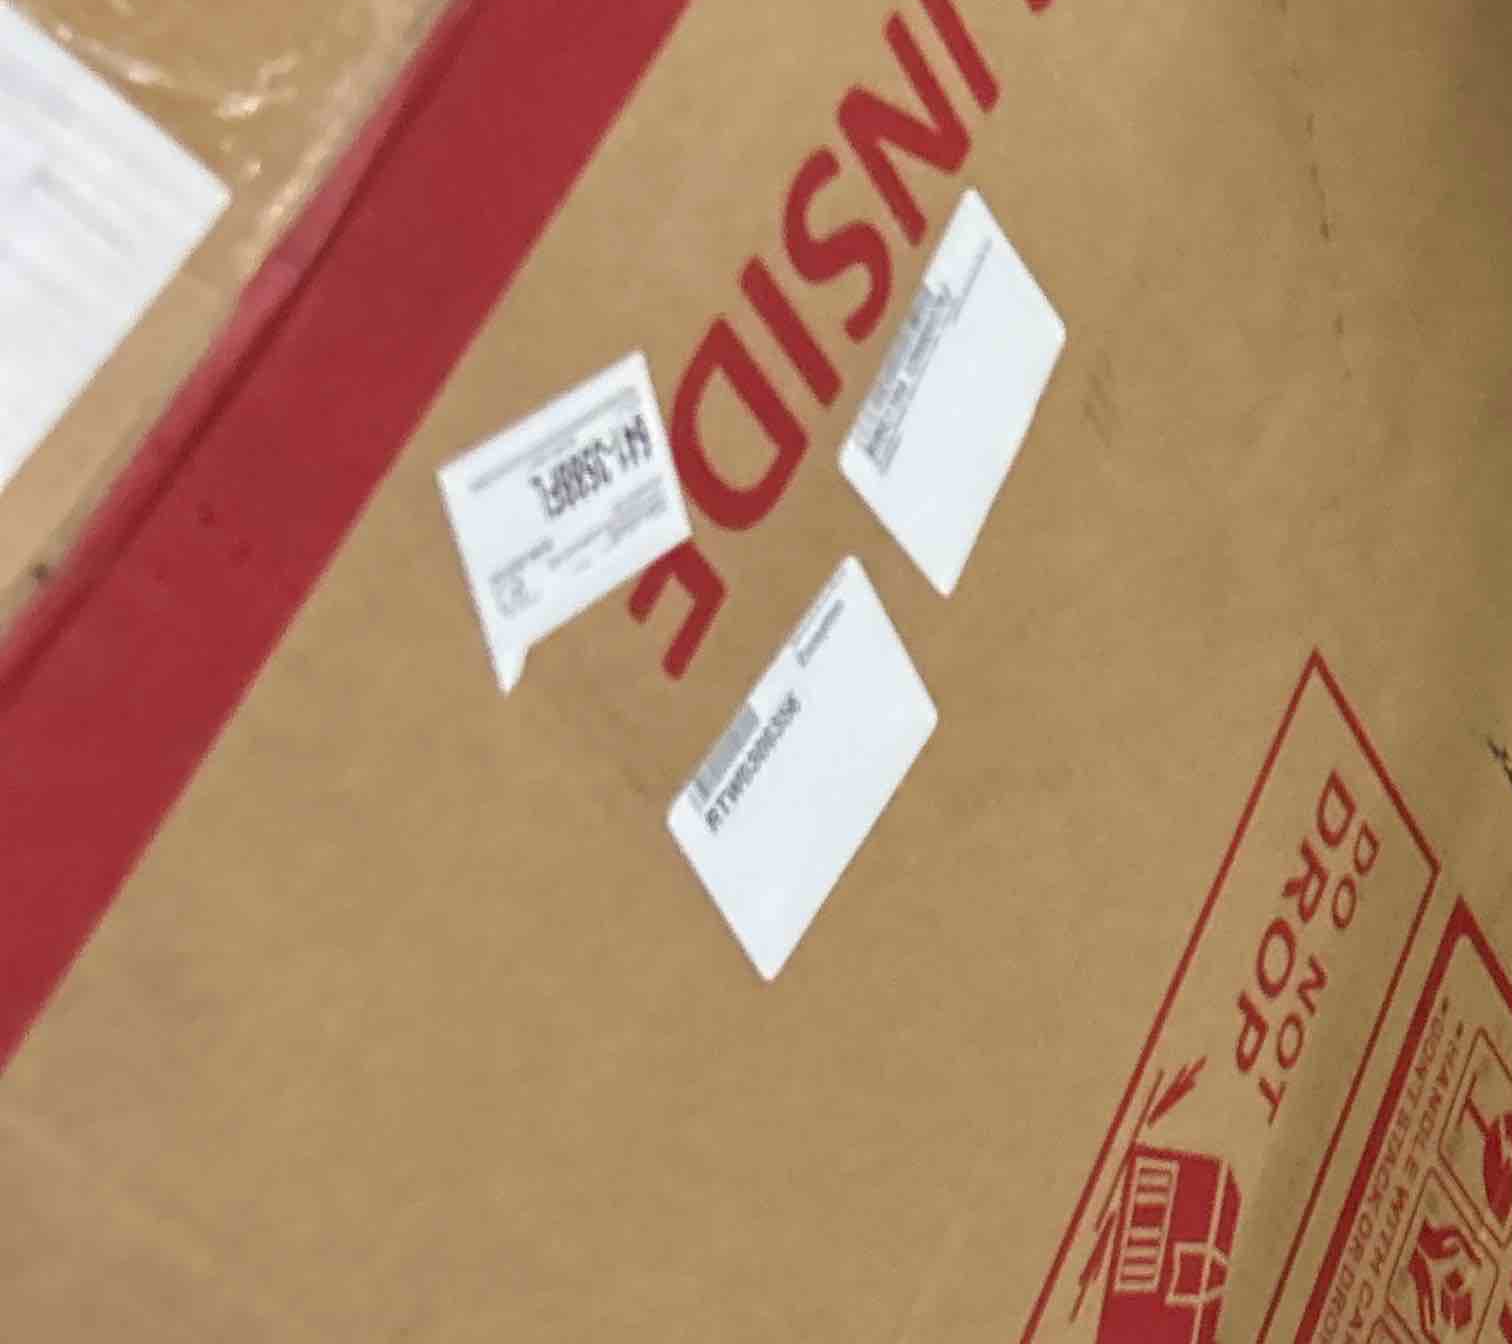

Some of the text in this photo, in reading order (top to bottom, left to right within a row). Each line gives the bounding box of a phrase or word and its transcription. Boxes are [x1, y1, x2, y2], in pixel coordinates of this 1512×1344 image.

[1234, 769, 1356, 1076] DROP
[1260, 816, 1383, 1126] DO NOT
